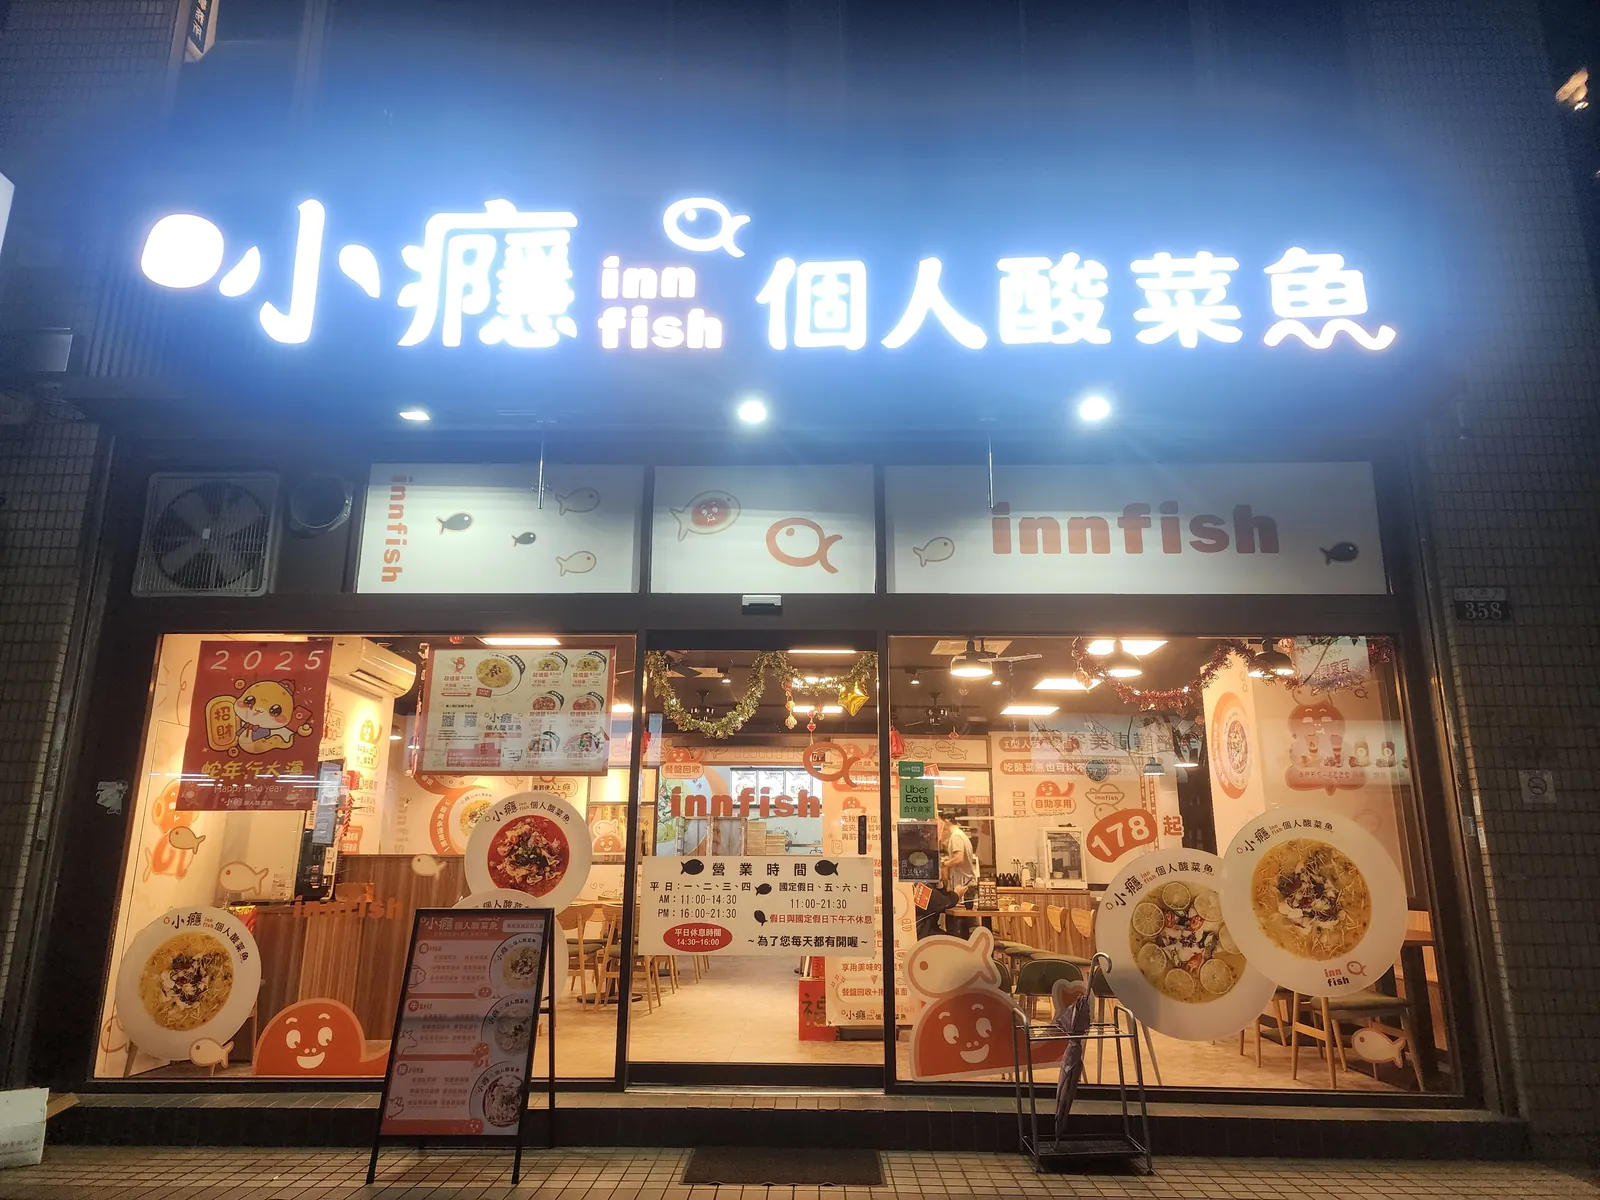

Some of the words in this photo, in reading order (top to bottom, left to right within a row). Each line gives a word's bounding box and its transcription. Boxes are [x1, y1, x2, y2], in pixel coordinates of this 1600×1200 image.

[600, 255, 696, 300] inn
[756, 246, 1397, 351] 個人酸菜魚
[597, 305, 723, 350] fish
[380, 475, 414, 584] innfish
[991, 501, 1281, 555] innfish
[1465, 602, 1502, 619] 358
[210, 650, 324, 671] 2025
[214, 706, 235, 741] 招財
[201, 760, 305, 780] 蛇年行大運
[214, 784, 243, 795] Happy
[264, 784, 284, 795] year
[905, 785, 929, 794] Uber
[905, 795, 929, 804] Eats
[670, 786, 821, 818] innfish
[1035, 799, 1072, 809] 自助享用
[530, 801, 571, 825] 個人酸菜魚
[1091, 815, 1150, 857] 178
[1163, 815, 1184, 836] 起
[1282, 818, 1335, 834] 個人酸菜魚
[1244, 826, 1272, 853] 小癮
[711, 862, 808, 877] 營業時間
[1155, 861, 1215, 877] 個人酸菜魚
[1113, 875, 1143, 907] 小癮
[171, 911, 202, 929] 小癮
[769, 914, 873, 925] 假日與國定假日下午不休息
[215, 920, 250, 964] 個人酸菜魚
[674, 928, 722, 937] 平日休息時間
[1323, 967, 1343, 978] inn
[1327, 976, 1351, 987] fish
